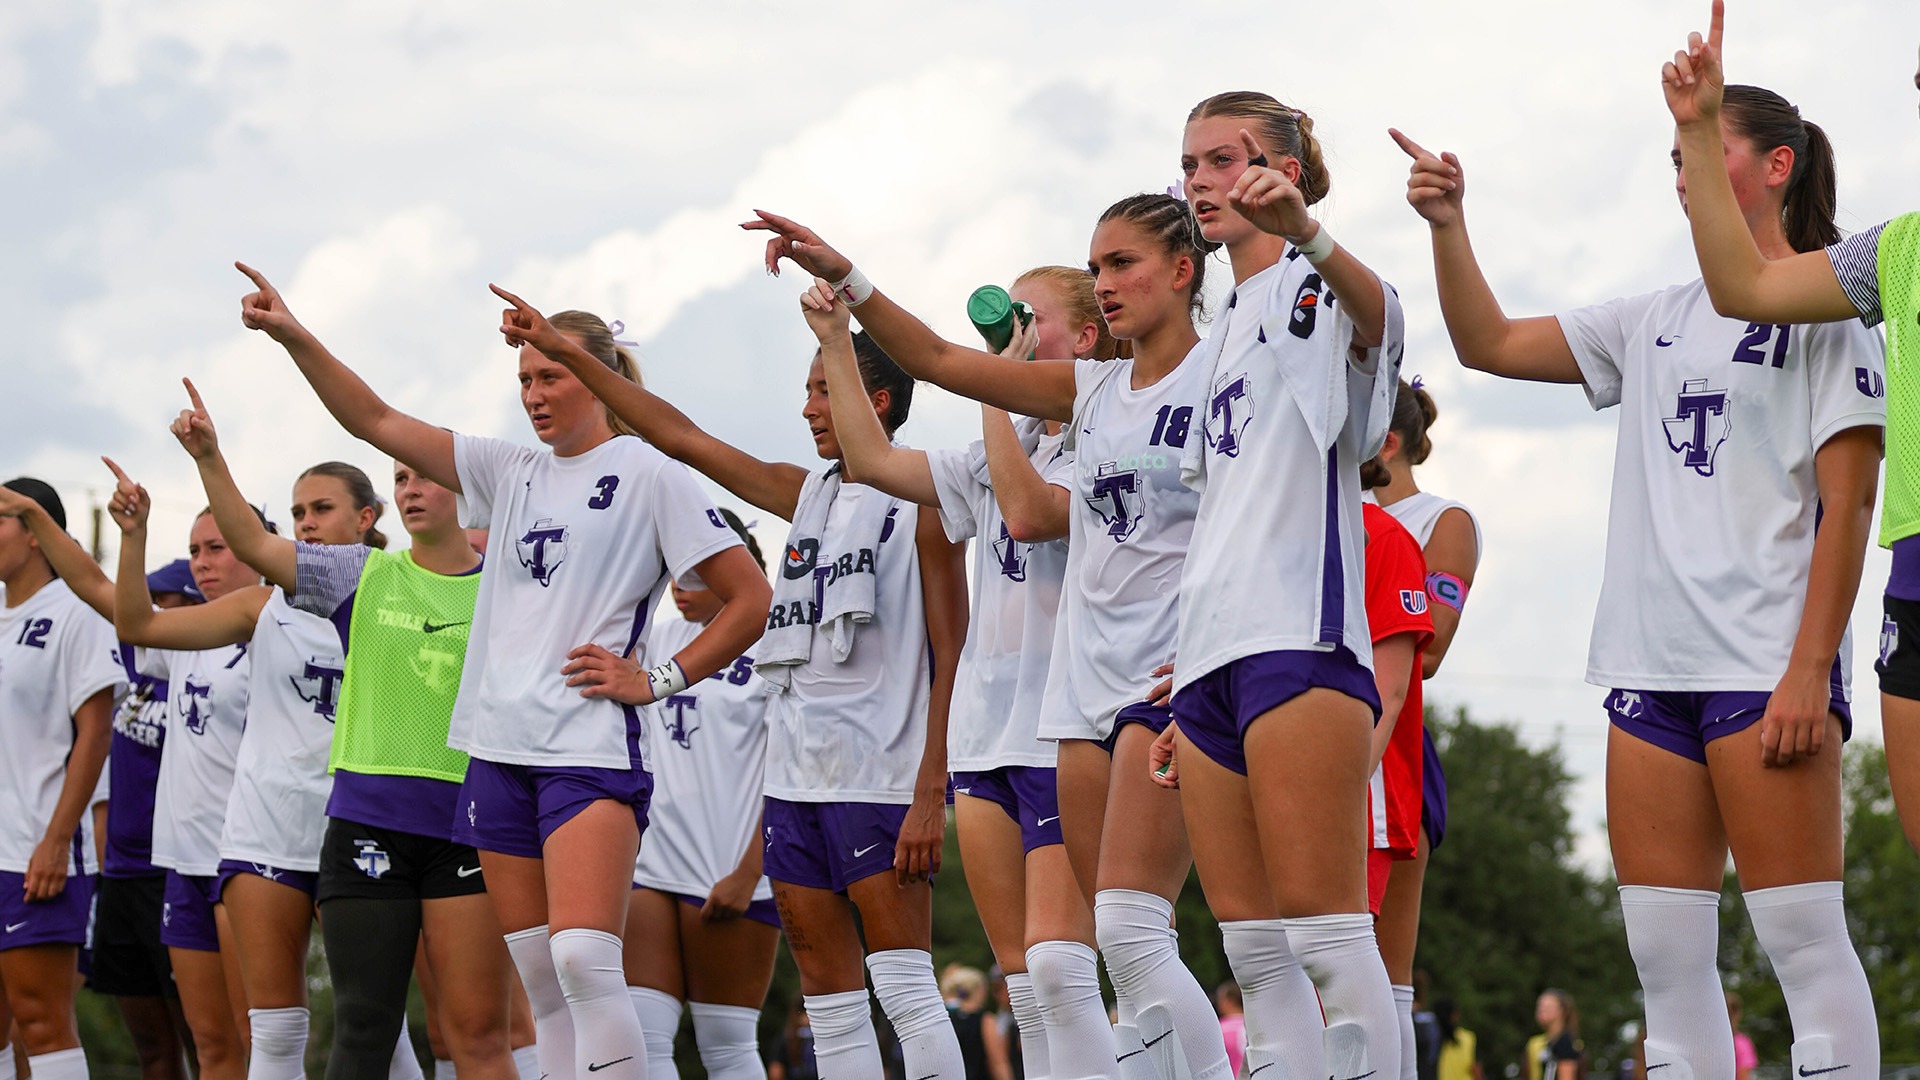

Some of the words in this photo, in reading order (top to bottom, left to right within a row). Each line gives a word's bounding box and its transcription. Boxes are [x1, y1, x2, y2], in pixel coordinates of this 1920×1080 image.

[1731, 321, 1792, 369] 21
[1148, 404, 1194, 449] 18
[1210, 372, 1248, 456] T
[1676, 388, 1728, 467] T
[587, 475, 620, 510] 3
[1093, 469, 1138, 536] T
[520, 525, 568, 579] T
[1437, 580, 1459, 601] C
[17, 618, 53, 650] 12
[303, 660, 345, 717] T
[665, 694, 698, 742] T
